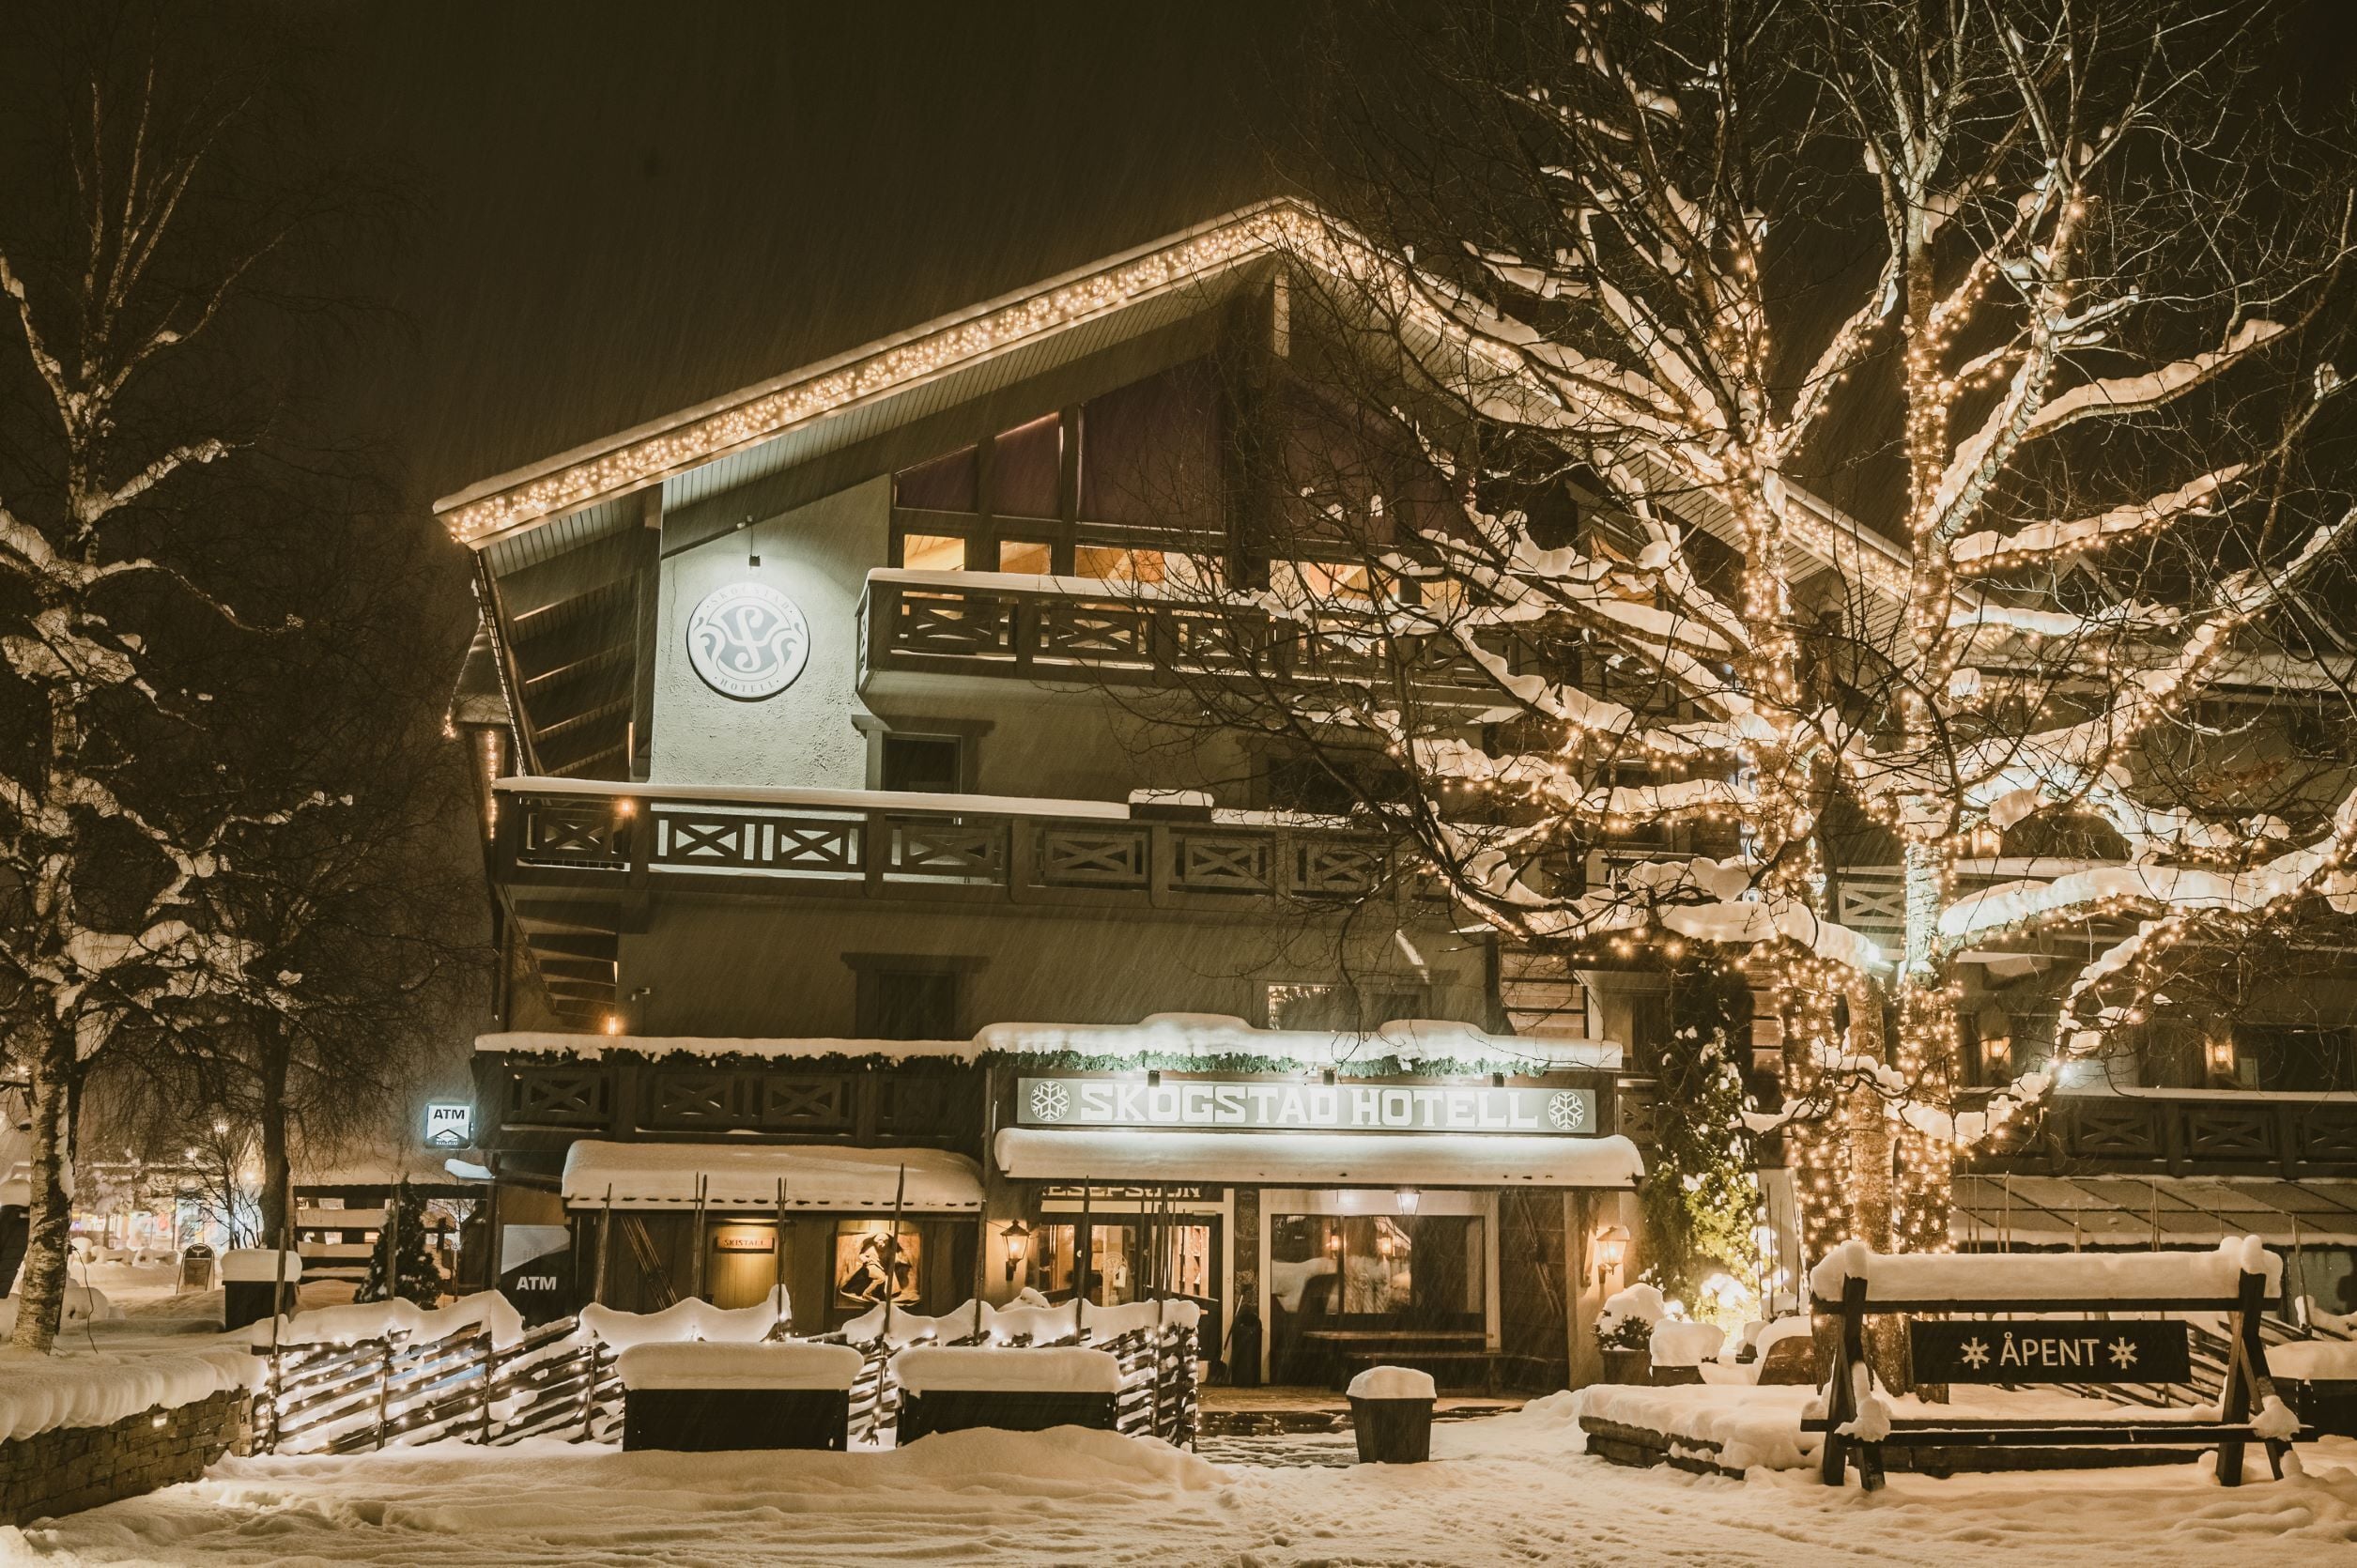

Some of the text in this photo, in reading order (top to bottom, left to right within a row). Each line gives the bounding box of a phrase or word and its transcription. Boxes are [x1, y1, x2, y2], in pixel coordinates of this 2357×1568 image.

[433, 1109, 465, 1120] ATM
[1080, 1084, 1539, 1129] SKOGSTAD HOTELL
[516, 1276, 557, 1291] ATM
[1999, 1331, 2101, 1367] ÅPENT
